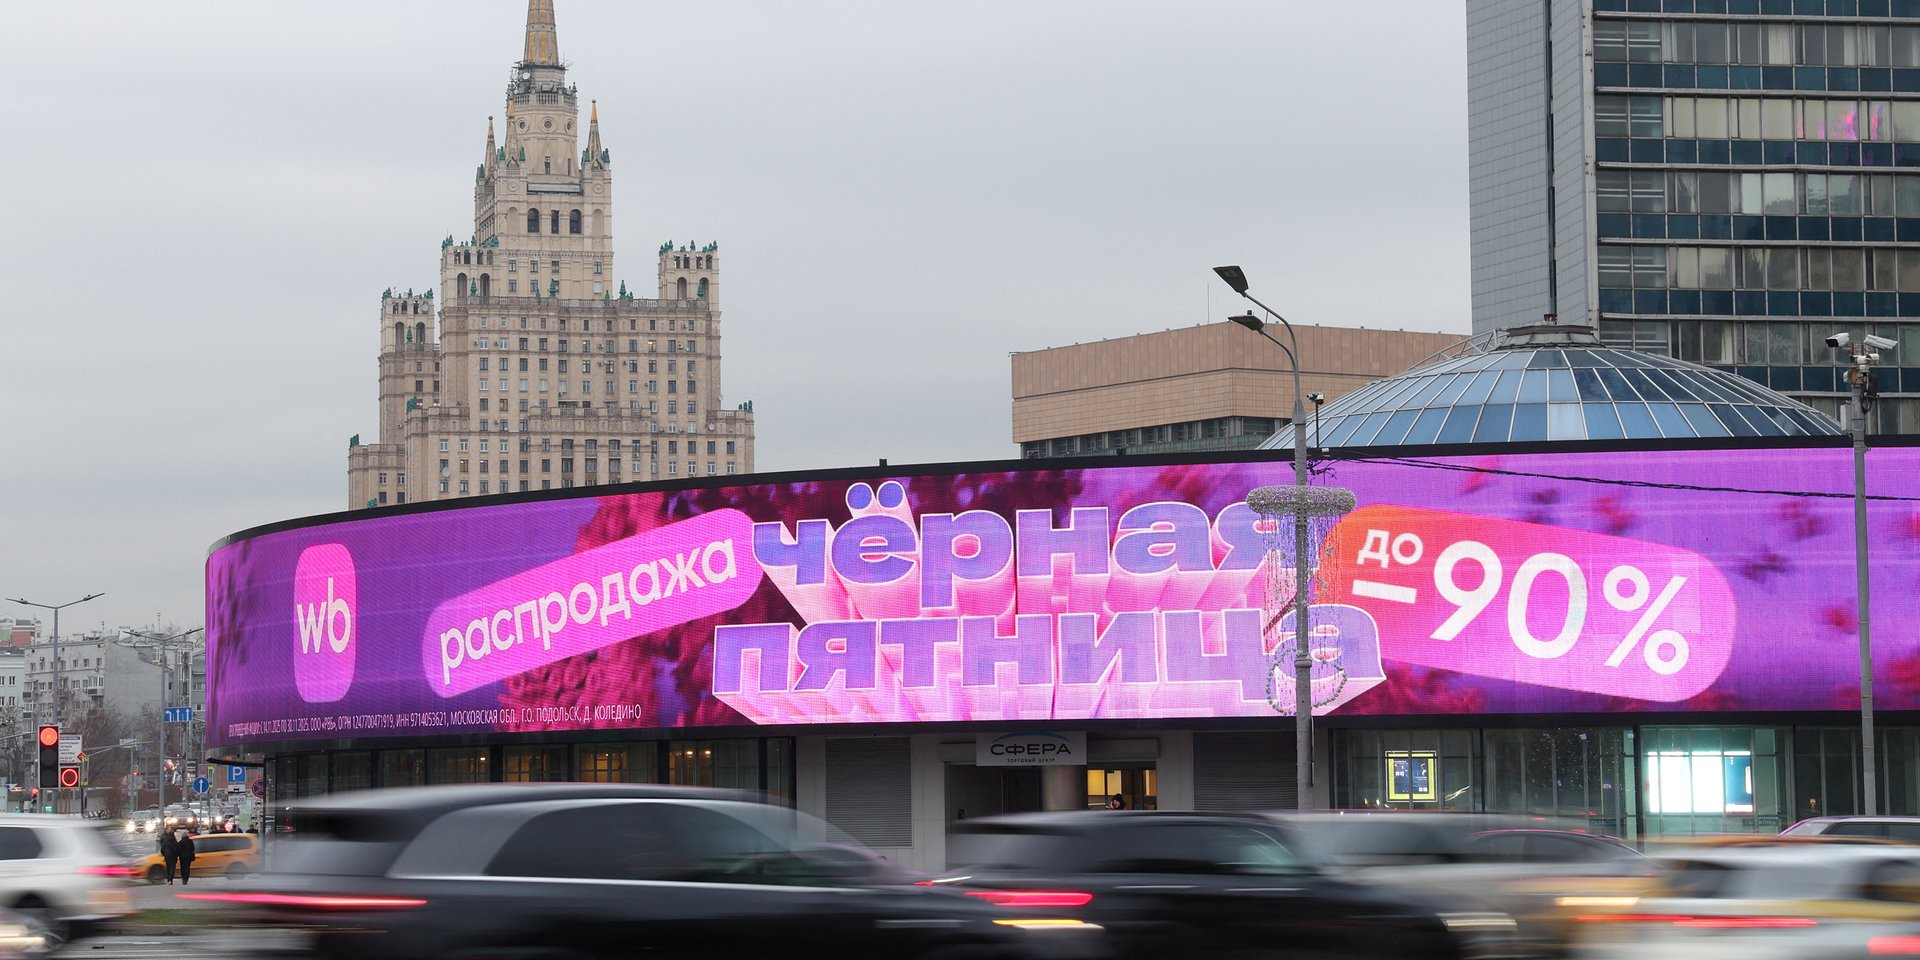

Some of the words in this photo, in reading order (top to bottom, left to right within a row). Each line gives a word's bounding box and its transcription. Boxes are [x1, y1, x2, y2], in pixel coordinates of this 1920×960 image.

[752, 481, 1319, 609] чёрная
[1357, 528, 1424, 567] до
[295, 576, 352, 656] wb
[440, 537, 738, 686] распродажа
[711, 603, 1387, 702] пятница
[338, 715, 352, 730] ОГРН
[396, 713, 410, 728] ИНН
[410, 711, 449, 728] 9714053621,
[450, 709, 498, 725] МОСКОВСКАЯ
[500, 708, 520, 725] ОБЛ.,
[521, 707, 535, 723] Г.О.
[536, 706, 582, 725] ПОДОЛЬСК,
[583, 705, 593, 724] Д.
[594, 703, 642, 721] КОЛЕДИНО
[990, 743, 1072, 755] СФЕРА
